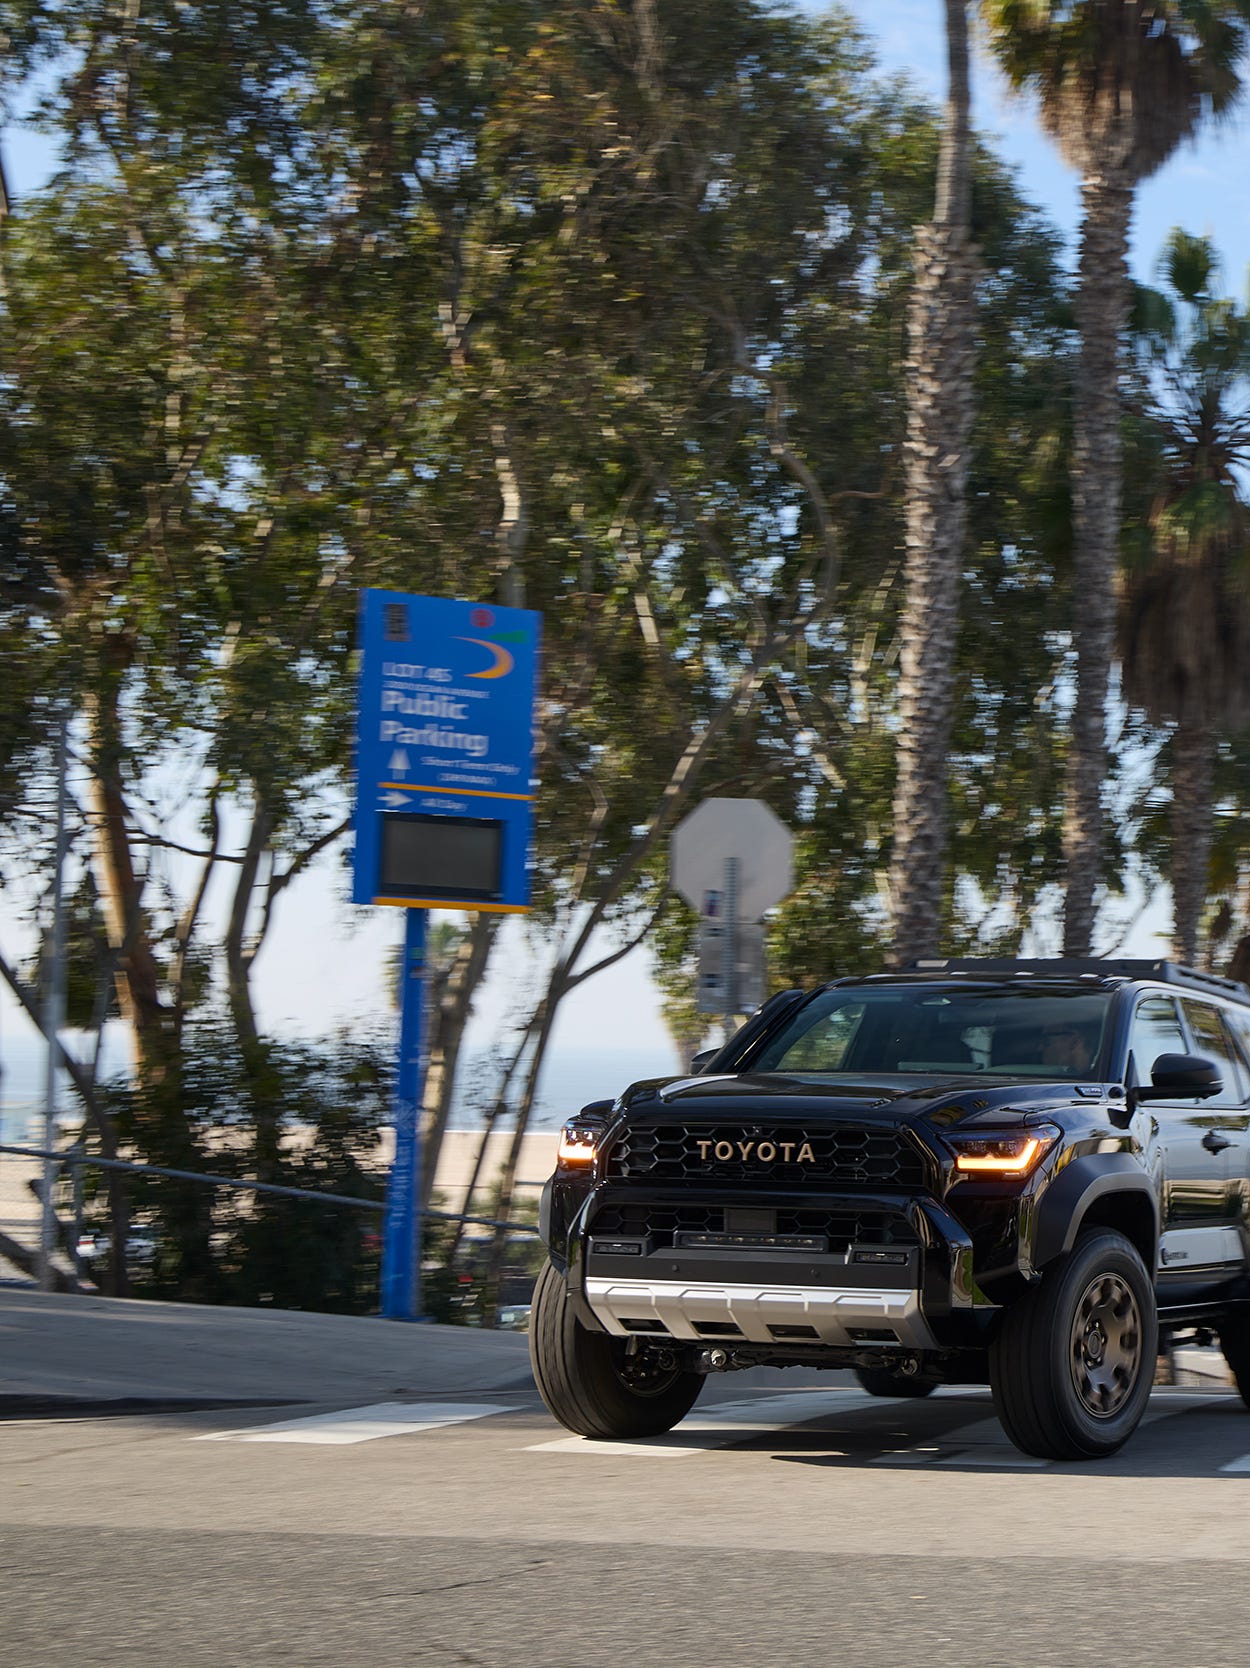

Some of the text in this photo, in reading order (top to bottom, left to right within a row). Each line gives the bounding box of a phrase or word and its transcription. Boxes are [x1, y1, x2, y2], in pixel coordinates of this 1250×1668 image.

[382, 662, 426, 679] LOT
[380, 690, 469, 720] Public
[379, 720, 489, 757] Parking
[696, 1140, 816, 1162] TOYOTA
